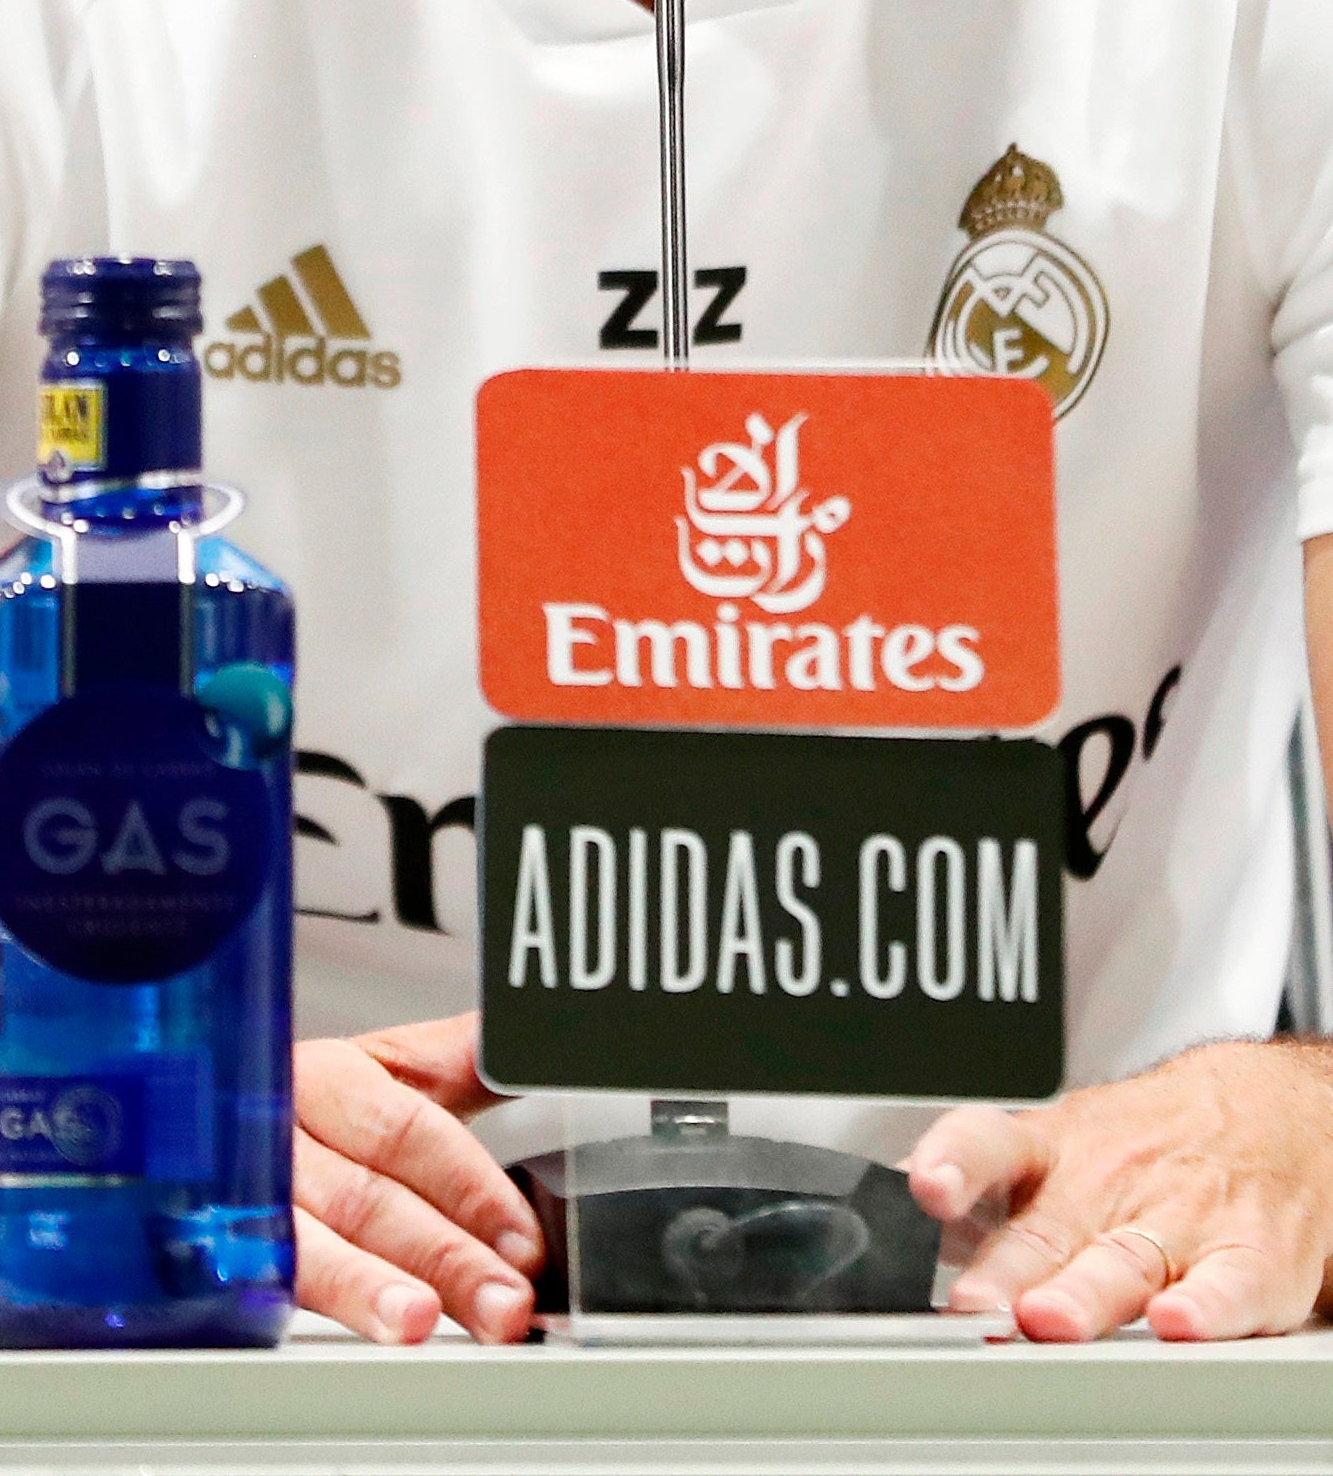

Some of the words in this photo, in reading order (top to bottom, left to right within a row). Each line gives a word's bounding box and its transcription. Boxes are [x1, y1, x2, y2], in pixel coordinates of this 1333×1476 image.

[204, 333, 402, 389] adidas
[543, 602, 985, 693] Emirates
[21, 796, 233, 876] GAS
[508, 823, 1040, 1004] ADIDAS.COM
